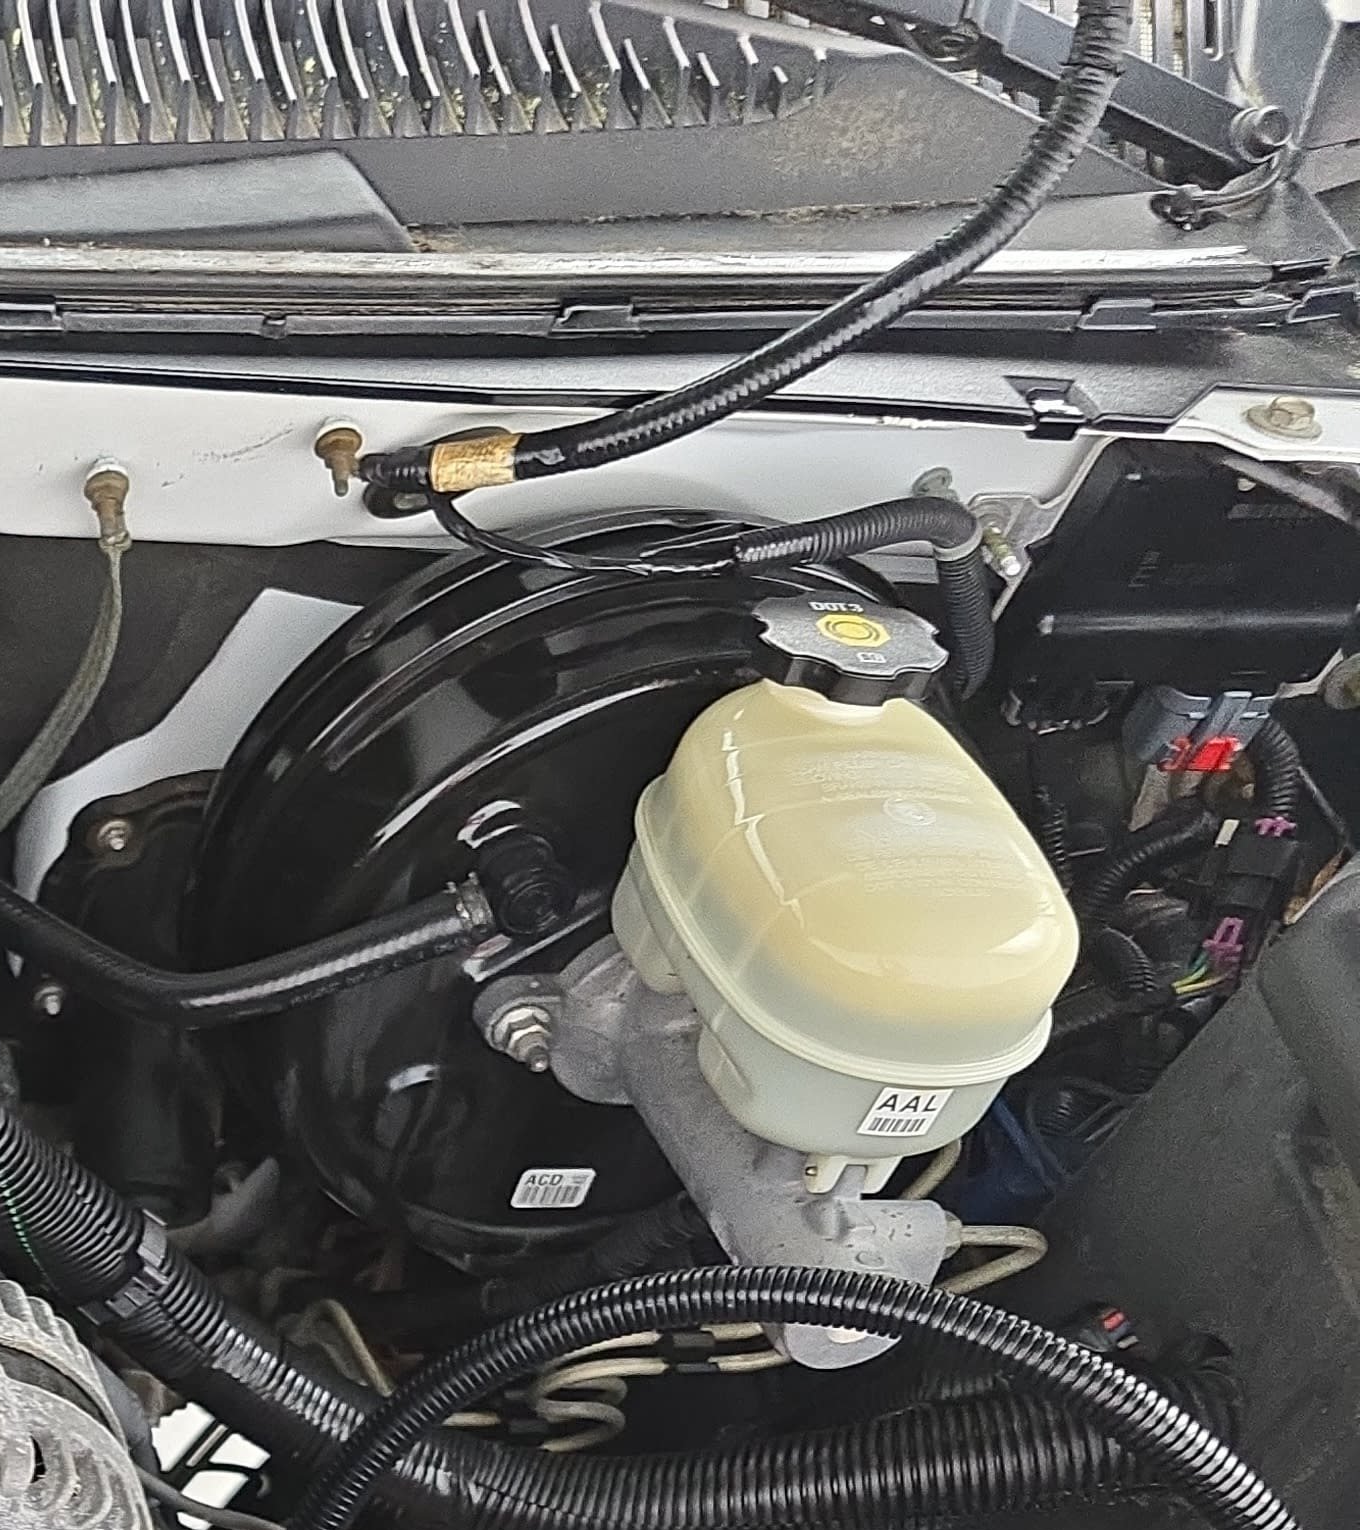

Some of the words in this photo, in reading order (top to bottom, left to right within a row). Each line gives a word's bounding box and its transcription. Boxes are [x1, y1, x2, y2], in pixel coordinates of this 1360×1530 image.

[808, 601, 848, 613] DOT
[849, 602, 865, 613] 3
[876, 1093, 938, 1113] AAL
[525, 1174, 564, 1186] ACD
